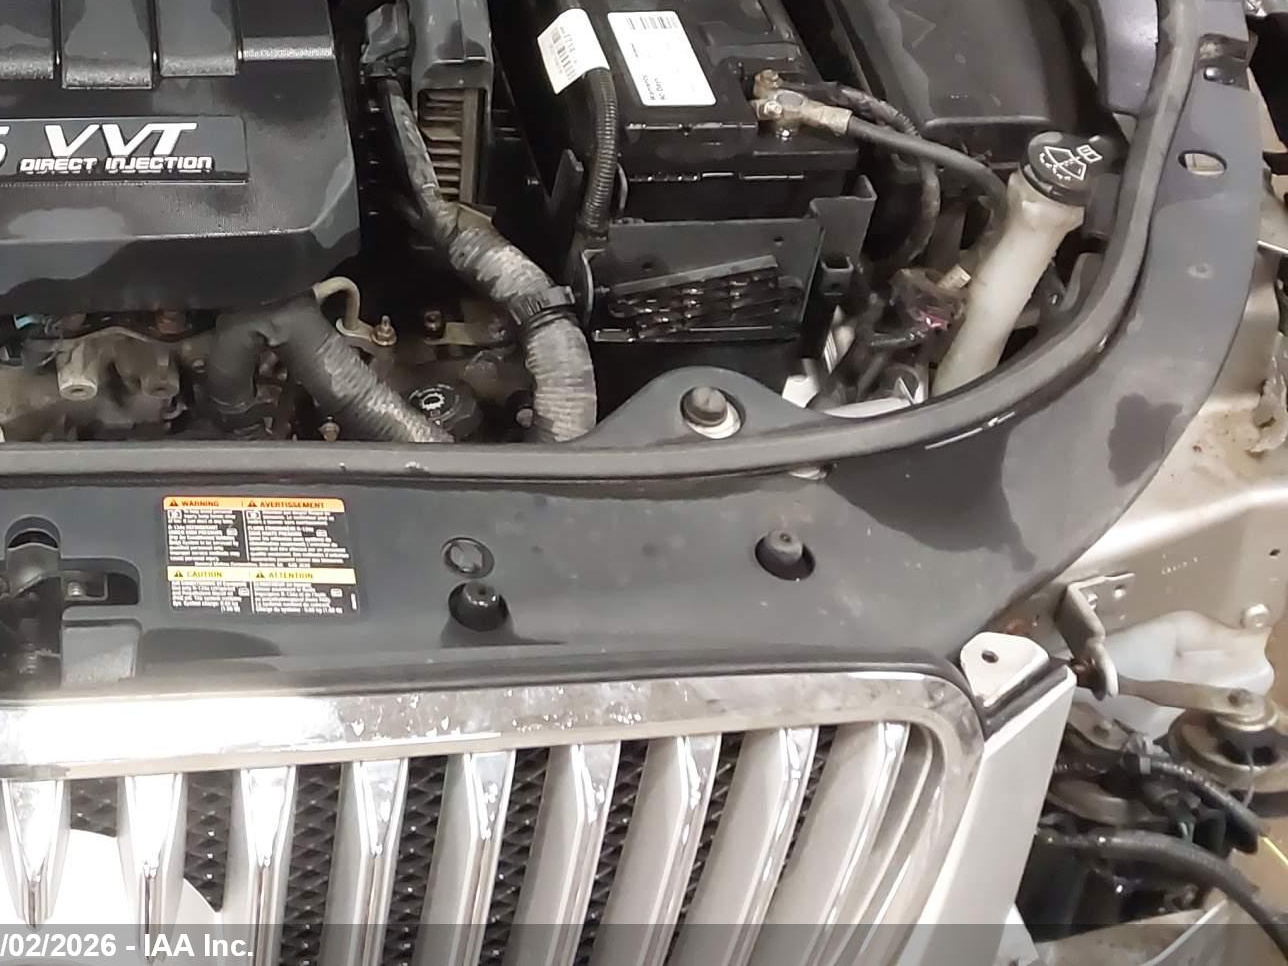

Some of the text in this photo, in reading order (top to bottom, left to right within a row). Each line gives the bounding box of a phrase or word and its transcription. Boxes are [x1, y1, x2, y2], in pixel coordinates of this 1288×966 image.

[44, 122, 198, 158] VVT
[20, 156, 213, 172] DIRECT INJECTION
[181, 499, 220, 507] WARNING
[259, 501, 325, 509] AVERTISSEMENT
